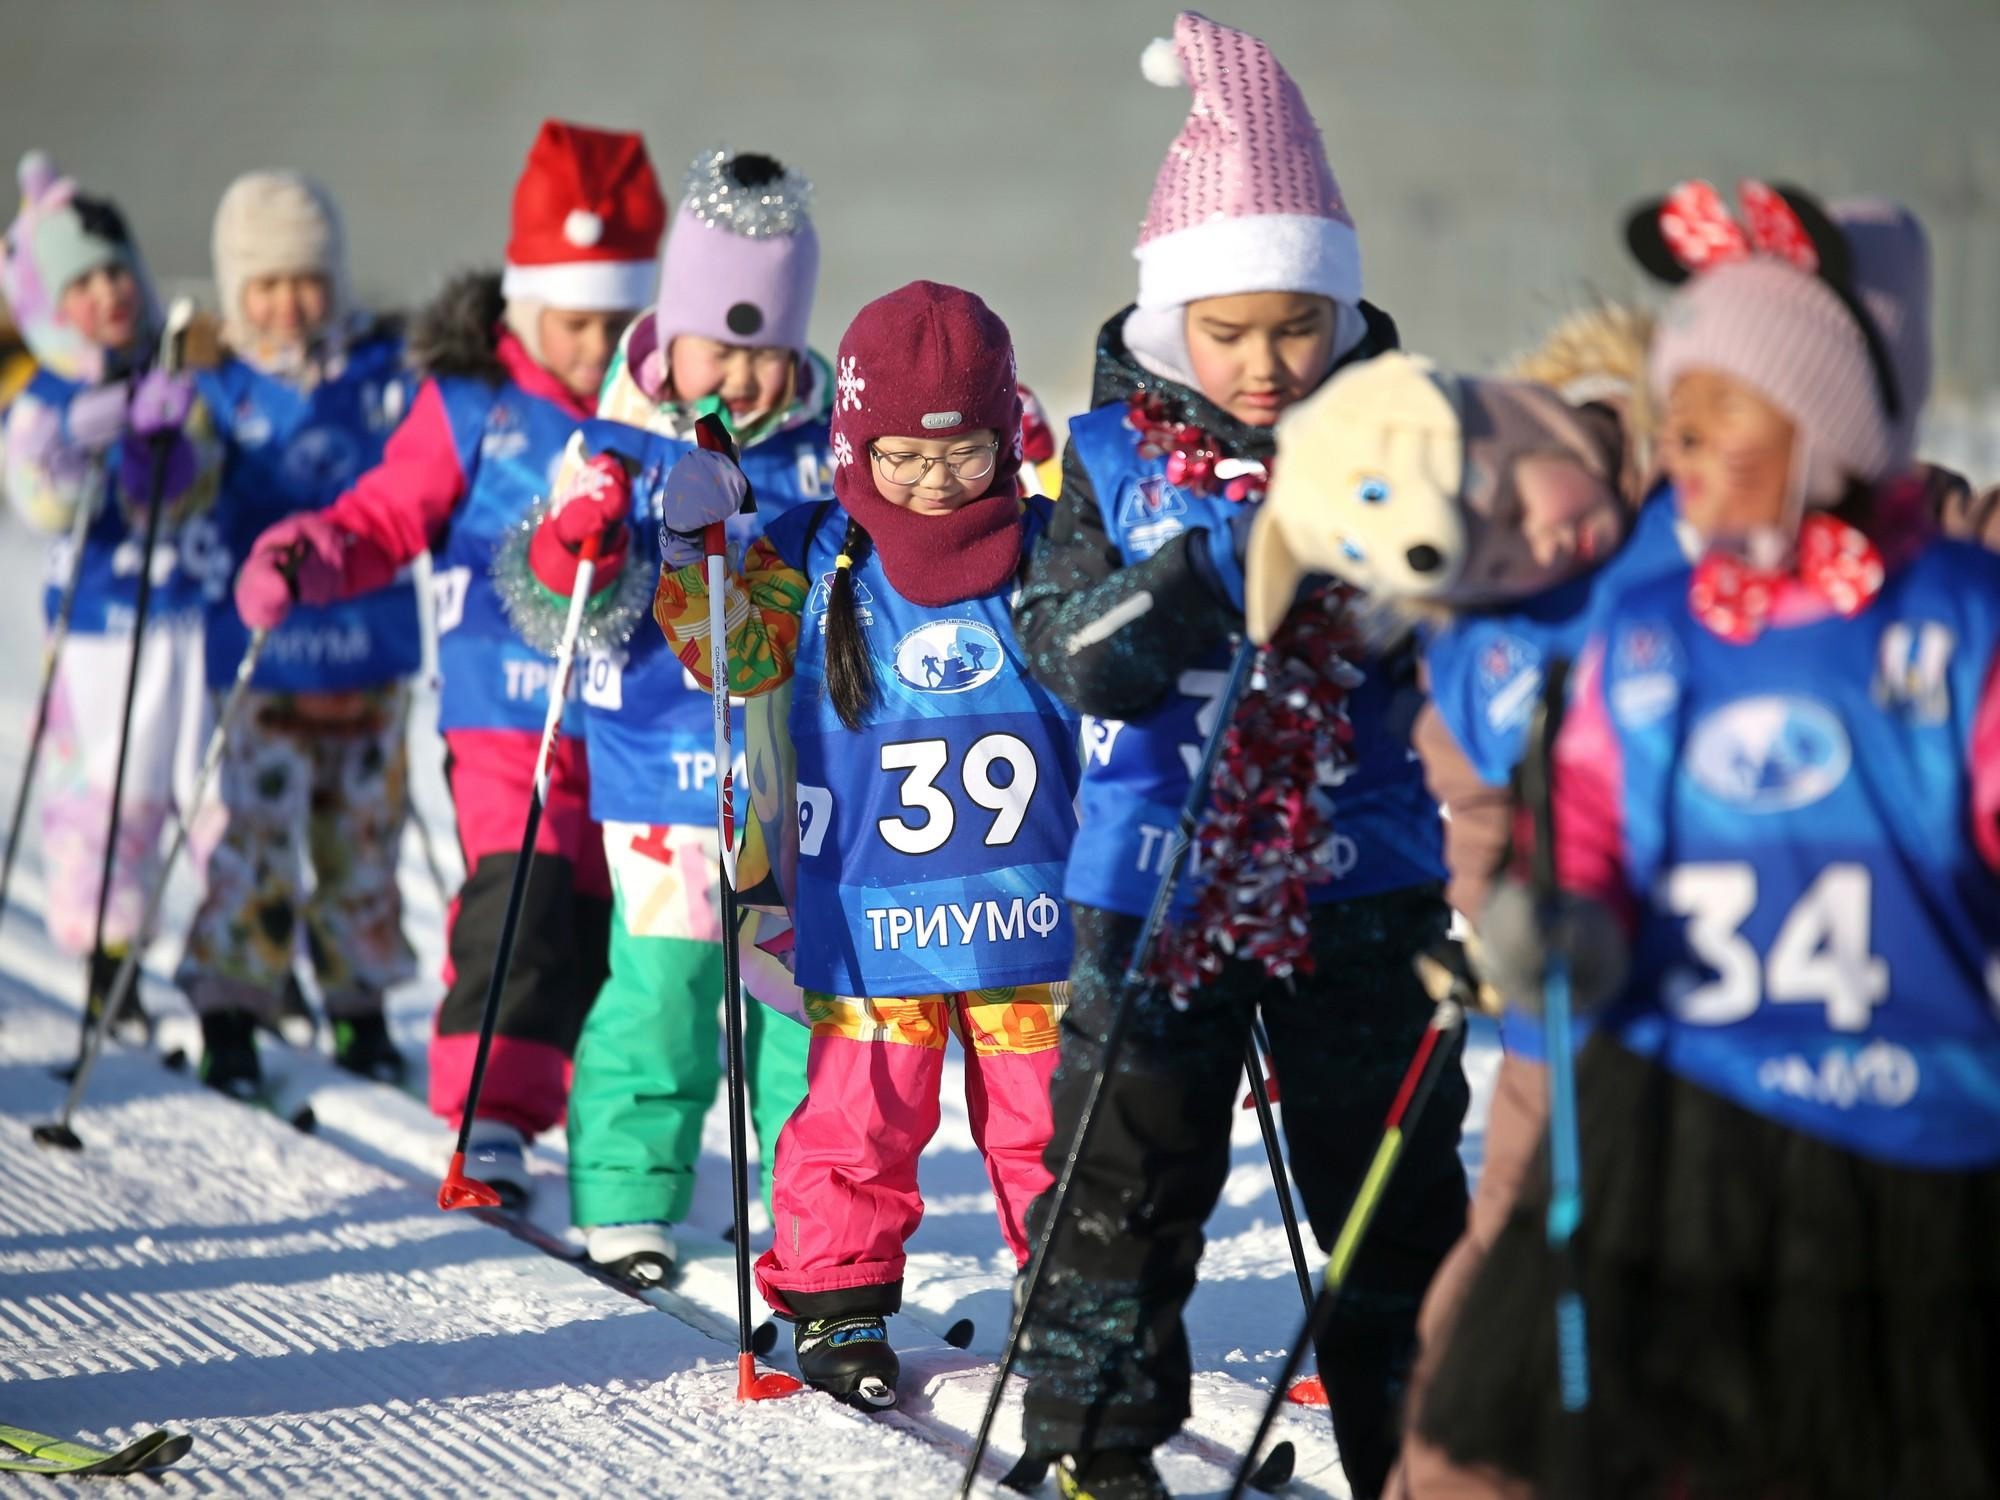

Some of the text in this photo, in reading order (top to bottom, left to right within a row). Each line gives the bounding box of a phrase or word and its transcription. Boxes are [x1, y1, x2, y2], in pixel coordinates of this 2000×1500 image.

[878, 732, 1038, 856] 39
[865, 892, 1060, 951] ТРИУМФ
[1661, 859, 1890, 1033] 34
